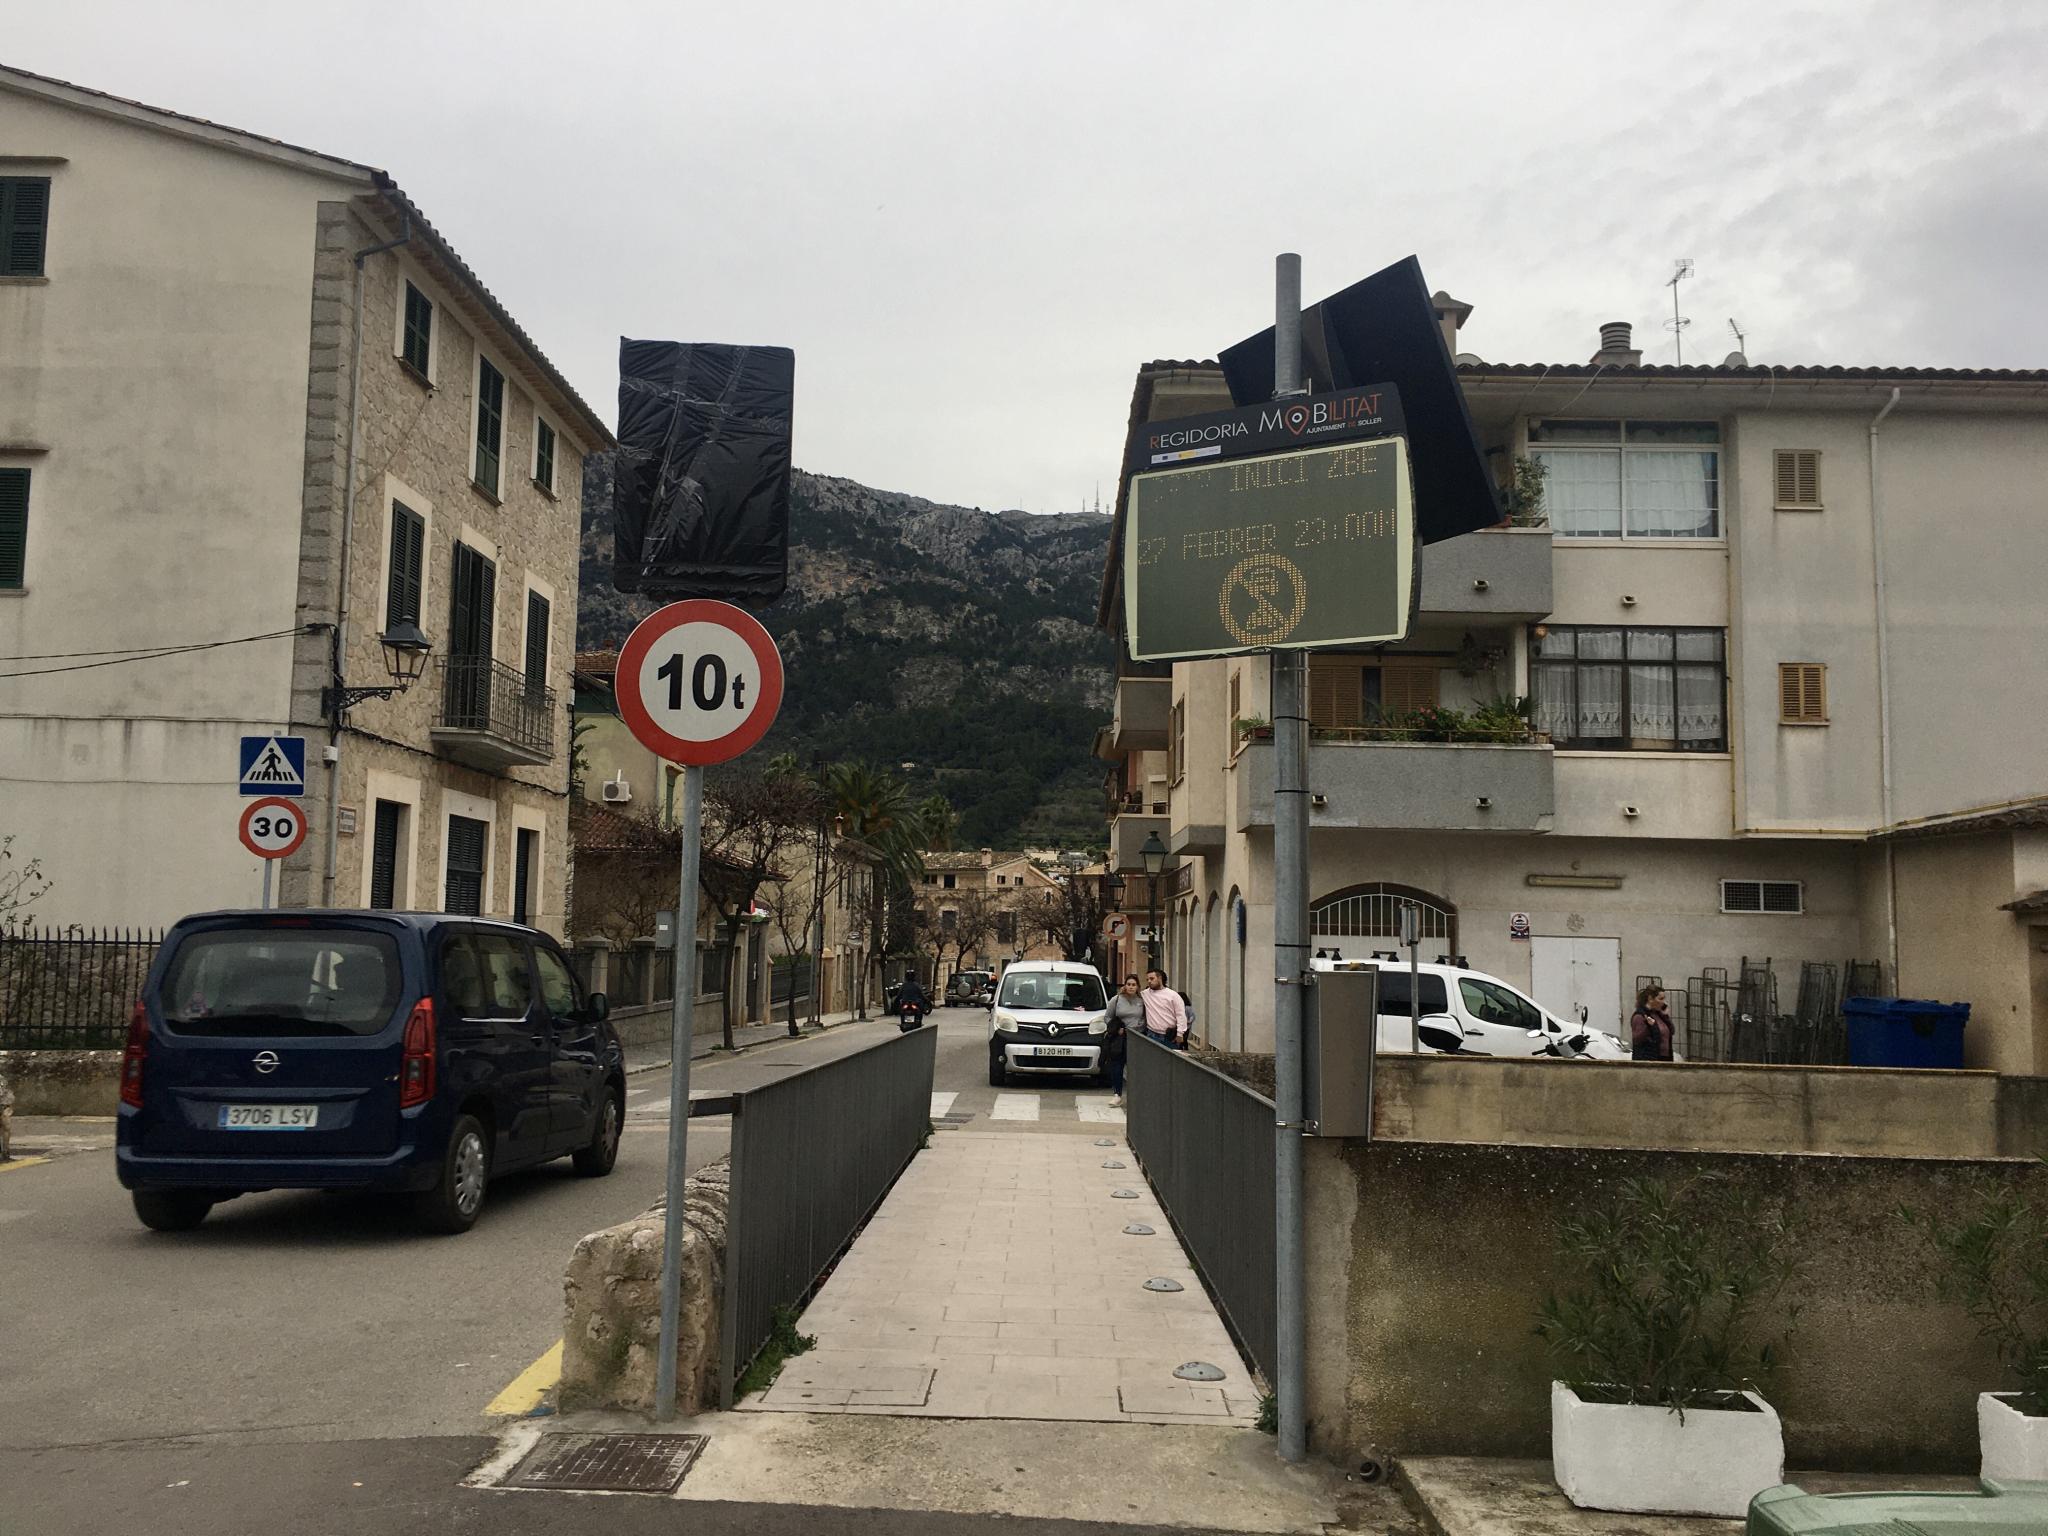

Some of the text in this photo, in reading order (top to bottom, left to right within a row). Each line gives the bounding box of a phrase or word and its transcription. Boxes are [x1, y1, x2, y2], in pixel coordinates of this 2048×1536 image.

[1149, 421, 1248, 449] REGIDORIA
[1306, 422, 1347, 434] AJUNTAMENT
[1230, 456, 1309, 492] INICI
[1328, 445, 1377, 479] ZBE
[1138, 536, 1166, 565] 27
[1183, 523, 1276, 560] FEBRER
[253, 816, 293, 838] 30
[231, 1108, 313, 1125] 3706 LSV
